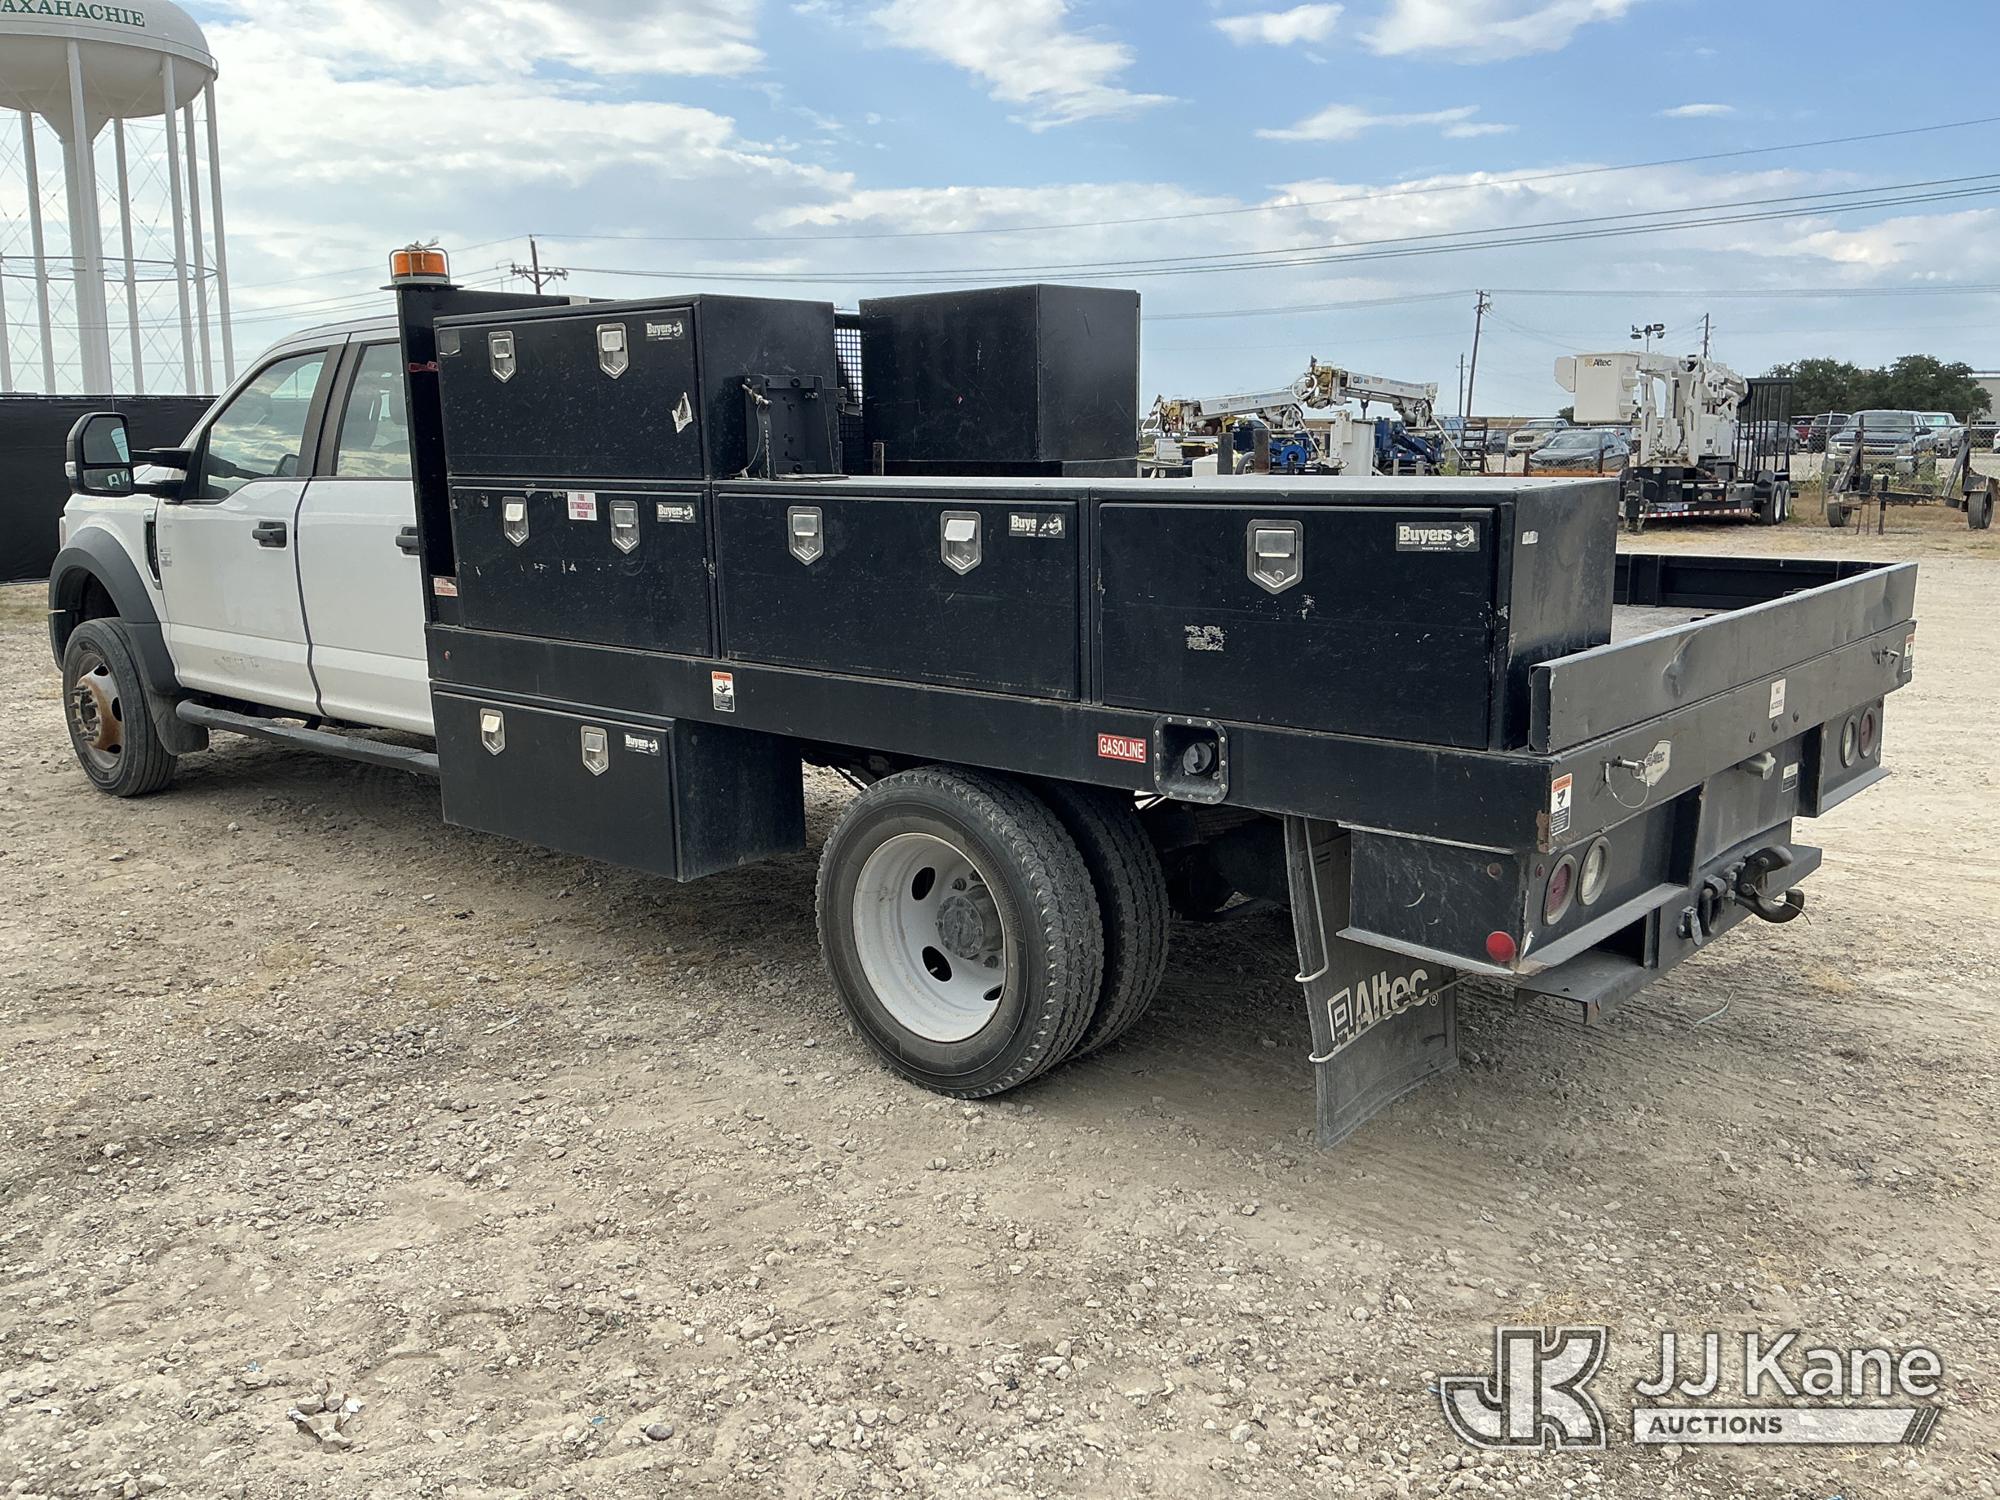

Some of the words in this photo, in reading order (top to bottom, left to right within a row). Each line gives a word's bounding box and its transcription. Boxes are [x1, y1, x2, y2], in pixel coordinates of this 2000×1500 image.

[646, 323, 672, 336] Buyers
[657, 504, 683, 517] Buyers
[1010, 515, 1047, 532] Buye
[1399, 526, 1453, 545] Buyers
[625, 734, 649, 748] Buyers
[1100, 737, 1144, 759] GASOLINE
[1355, 968, 1429, 1035] Altec
